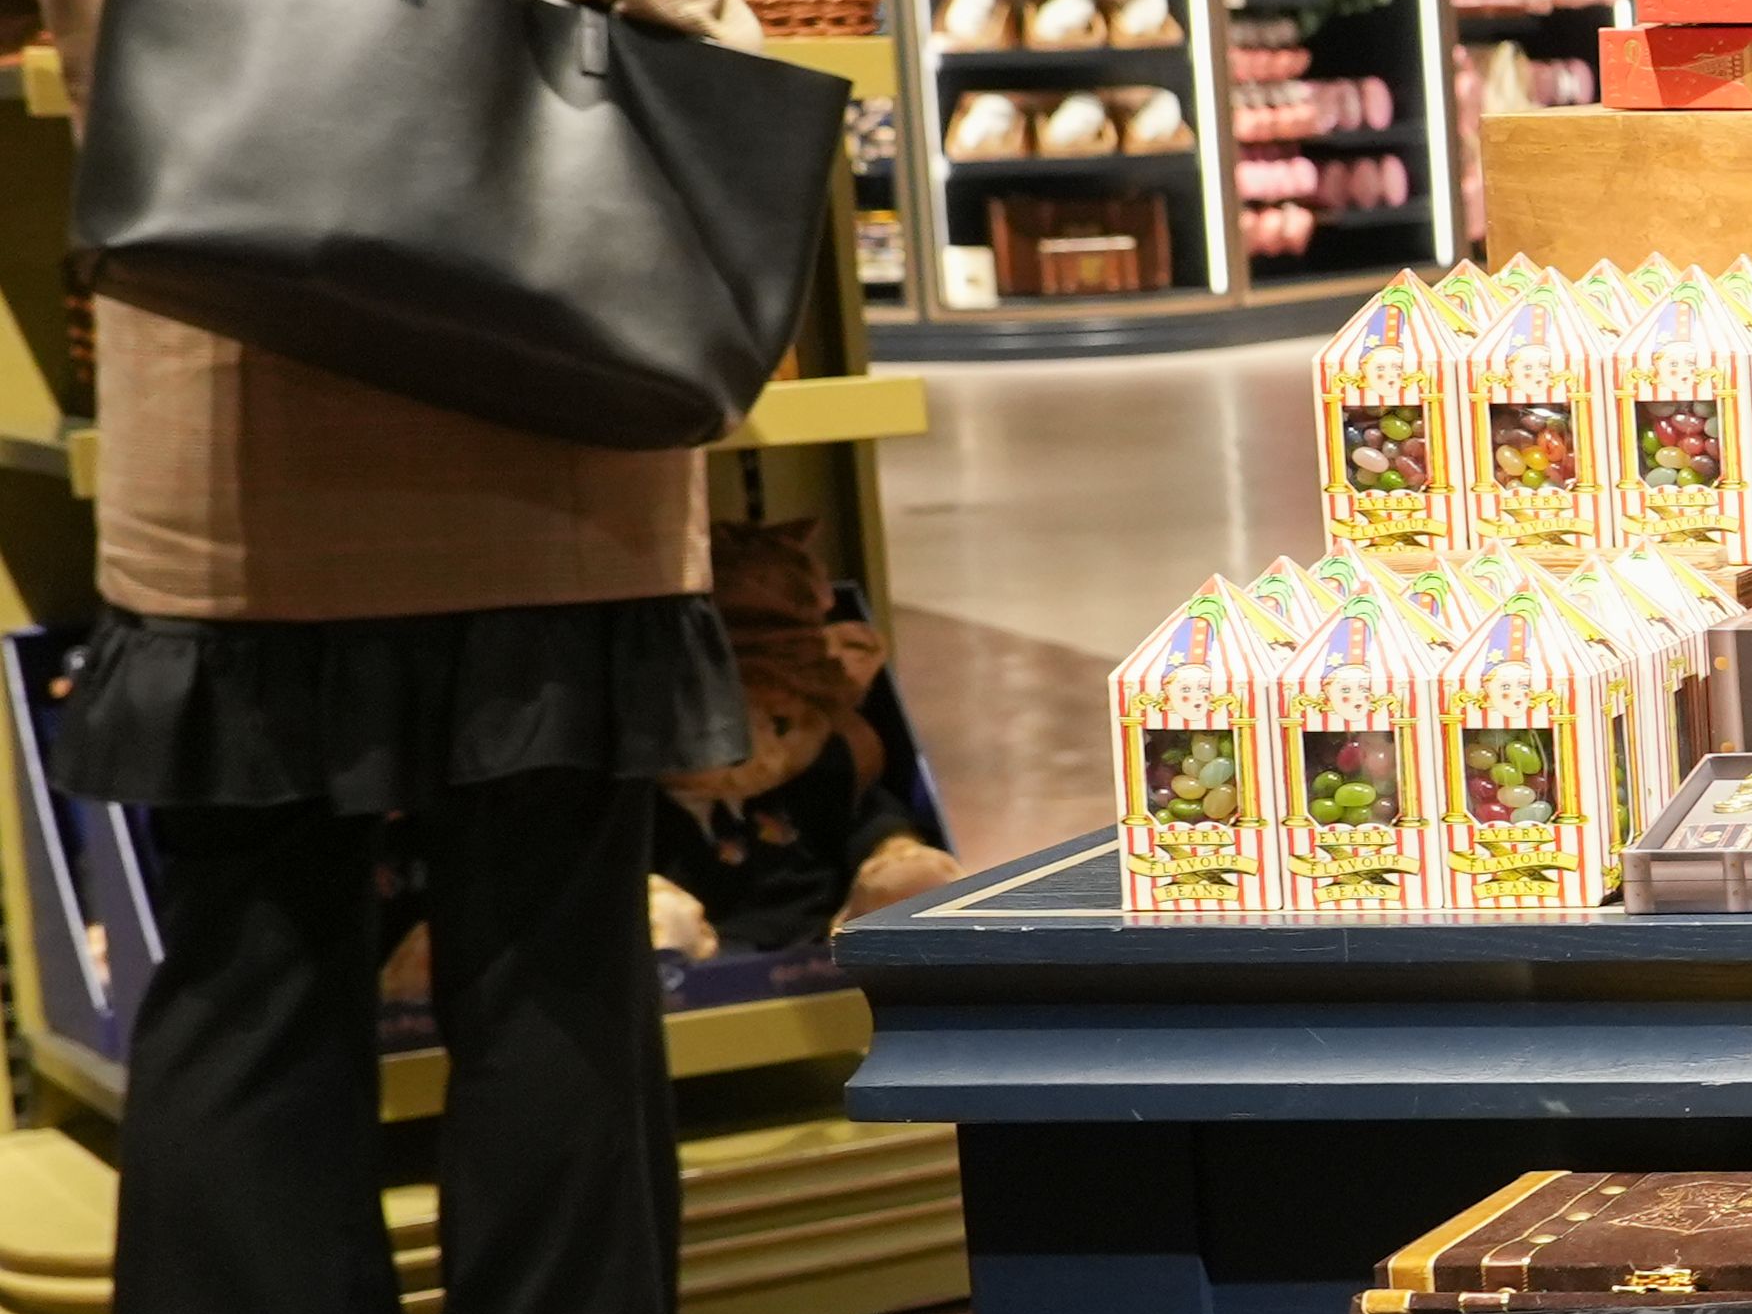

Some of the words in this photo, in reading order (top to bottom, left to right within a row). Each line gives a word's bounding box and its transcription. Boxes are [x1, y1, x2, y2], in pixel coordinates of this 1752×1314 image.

[1357, 496, 1420, 509] EVERY
[1503, 495, 1567, 509] EVERY
[1649, 493, 1713, 507] EVERY
[1346, 518, 1430, 538] FLAVOUR
[1497, 518, 1587, 536] FLAVOUR
[1639, 515, 1722, 533] FLAVOUR
[1157, 831, 1228, 844] EVERY
[1318, 831, 1387, 844] EVERY
[1477, 828, 1547, 842] EVERY
[1146, 855, 1240, 874] FLAVOUR
[1310, 855, 1401, 875] FLAVOUR
[1468, 851, 1560, 872] FLAVOUR
[1164, 886, 1226, 898] BEANS
[1324, 885, 1387, 899] BEANS
[1482, 881, 1545, 895] BEANS
